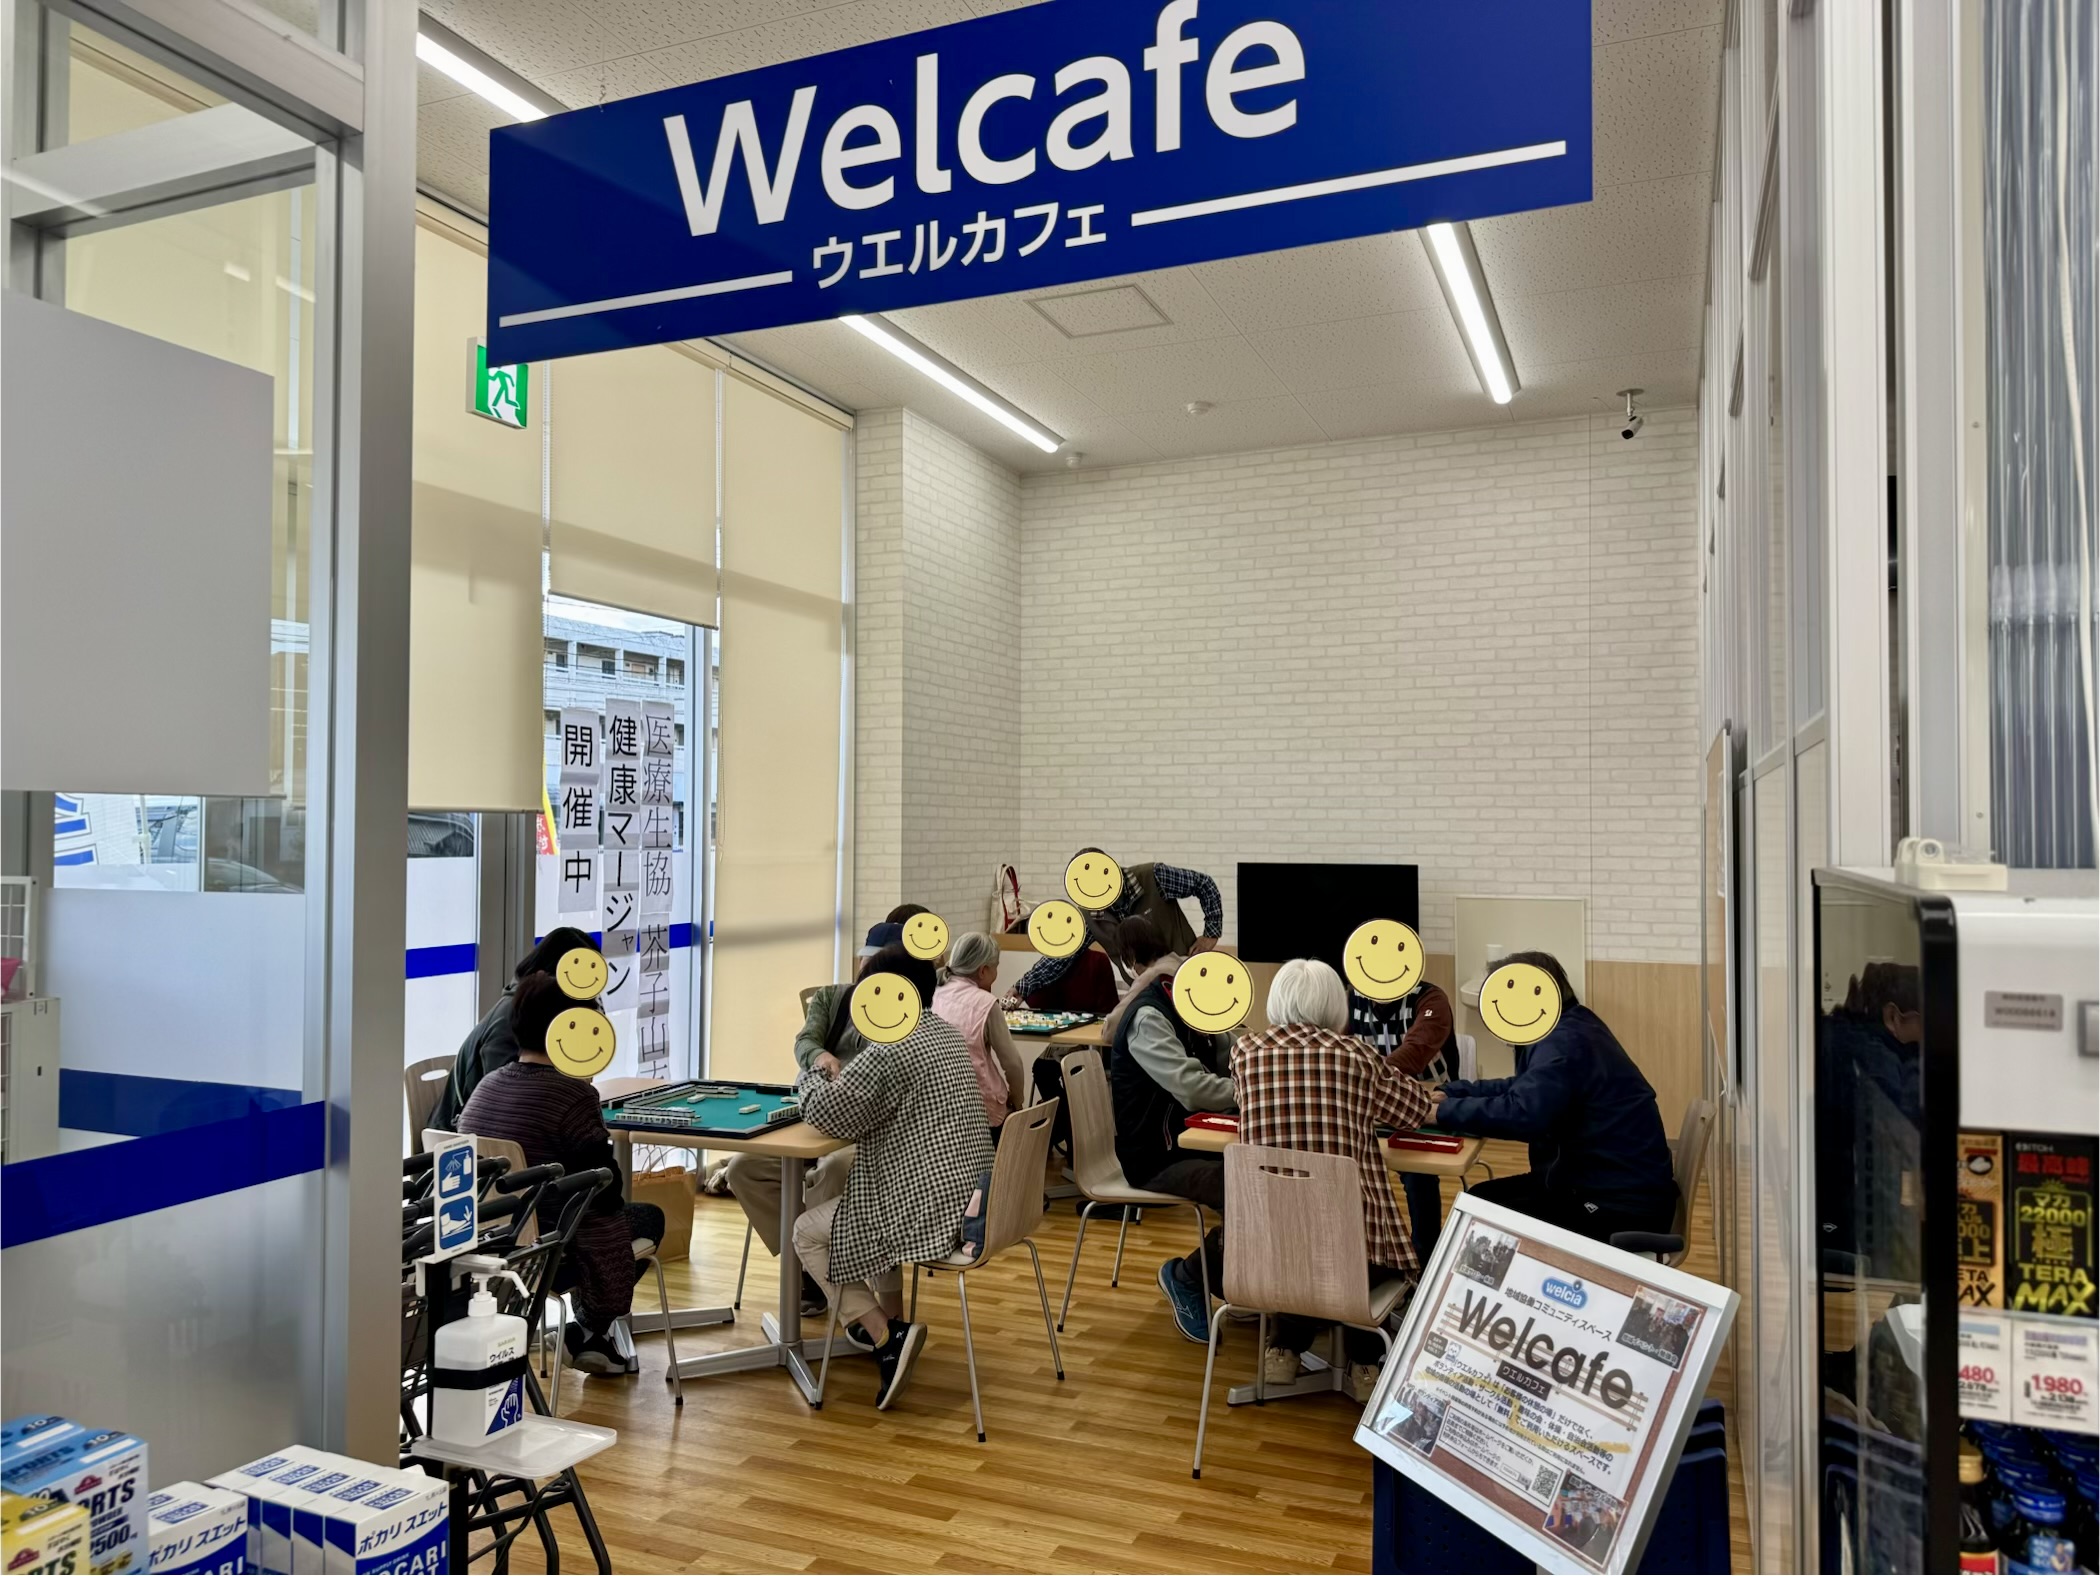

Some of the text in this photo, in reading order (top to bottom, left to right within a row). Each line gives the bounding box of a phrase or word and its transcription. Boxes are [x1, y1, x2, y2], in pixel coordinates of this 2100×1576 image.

[663, 0, 1306, 238] Welcafe
[812, 203, 1107, 289] ウエルカフェ
[562, 723, 593, 894] 開催中
[642, 714, 672, 897] 医療生協
[606, 714, 639, 997] 健康マージャン
[2020, 1205, 2086, 1227] 22000
[2032, 1191, 2071, 1208] マカ
[1544, 1280, 1583, 1305] welcia
[2012, 1281, 2097, 1315] MAX
[2018, 1262, 2090, 1284] TERA
[1503, 1286, 1613, 1342] 地域協働コミュニティスペース
[1458, 1288, 1633, 1410] Welcafe
[1500, 1364, 1546, 1395] ウエルカフェ
[357, 1501, 447, 1555] ポカリスエット
